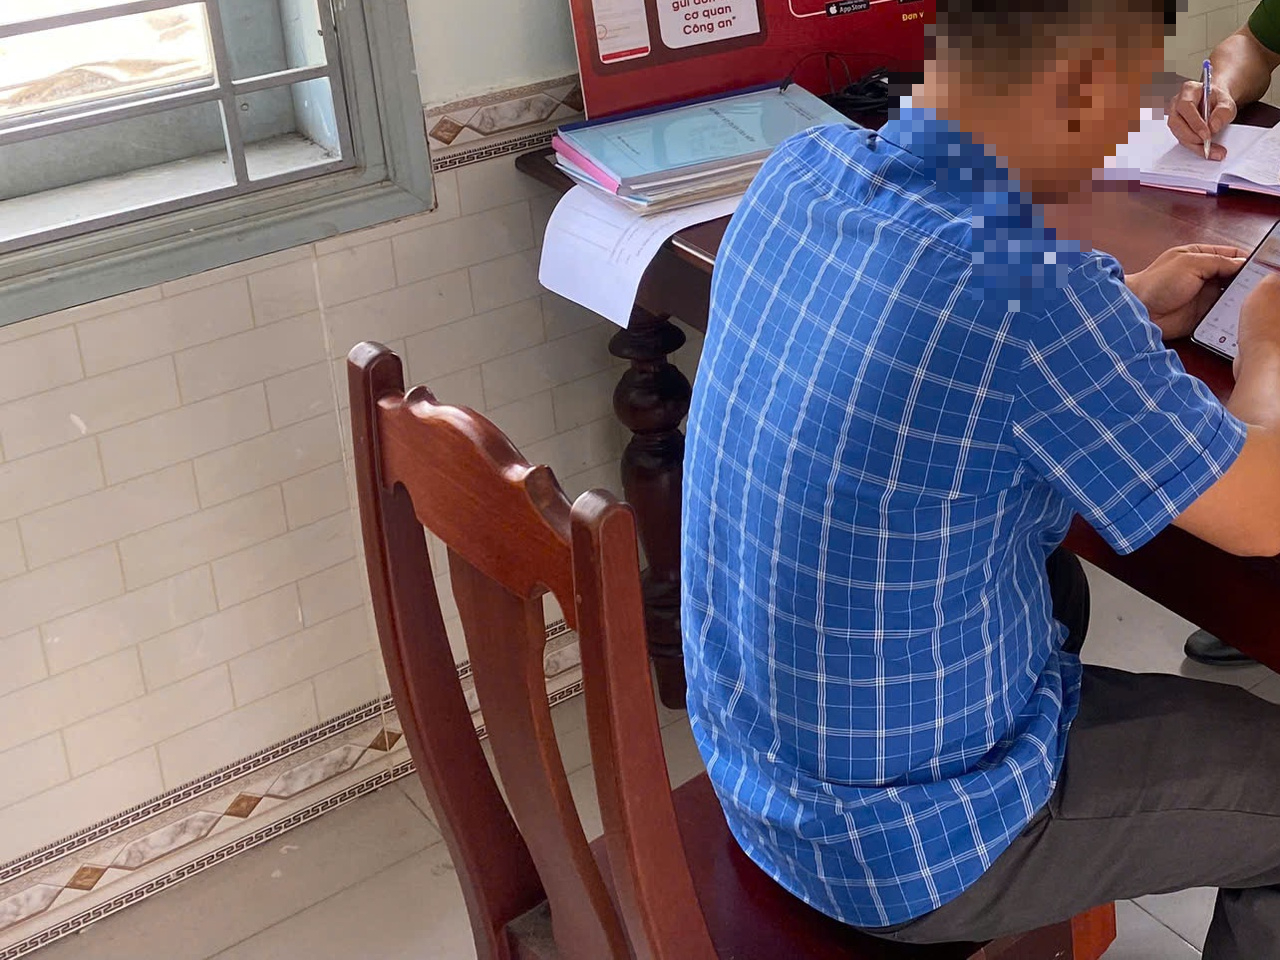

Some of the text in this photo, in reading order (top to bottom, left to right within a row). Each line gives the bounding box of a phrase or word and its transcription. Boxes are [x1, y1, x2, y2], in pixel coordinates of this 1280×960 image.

[685, 5, 731, 20] cơ quan
[840, 3, 867, 13] App Store
[683, 22, 714, 35] Công
